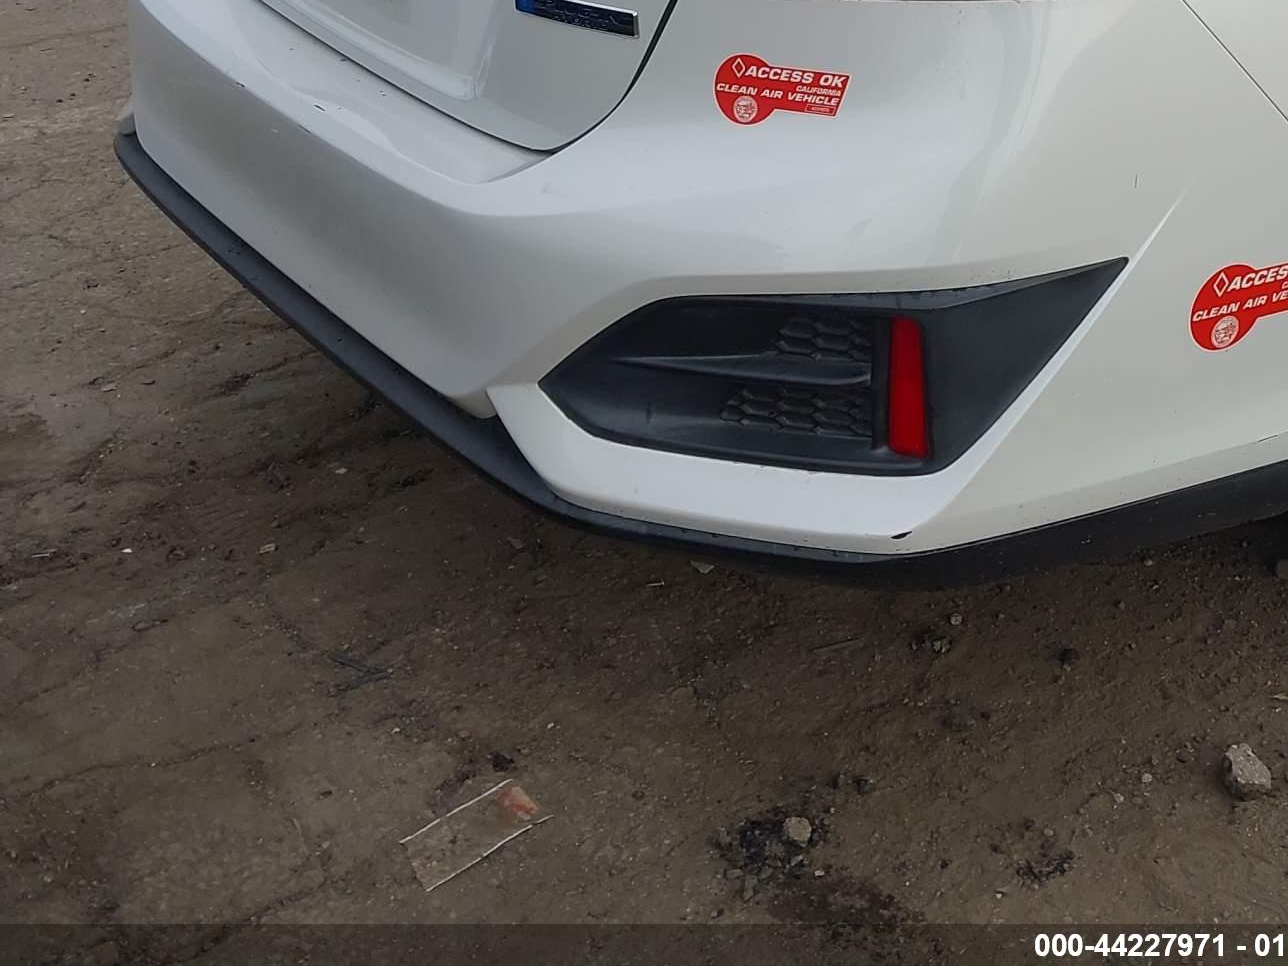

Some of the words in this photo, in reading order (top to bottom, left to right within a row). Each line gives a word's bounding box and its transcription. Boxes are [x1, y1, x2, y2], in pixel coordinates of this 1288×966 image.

[745, 65, 814, 84] ACCESS
[819, 74, 847, 88] OK
[716, 82, 758, 95] CLEAN
[760, 89, 783, 99] AIR
[787, 92, 840, 106] VEHICLE
[796, 85, 842, 97] CALIFORNIA
[1192, 302, 1240, 322] CLEAN
[1242, 296, 1268, 310] AIR
